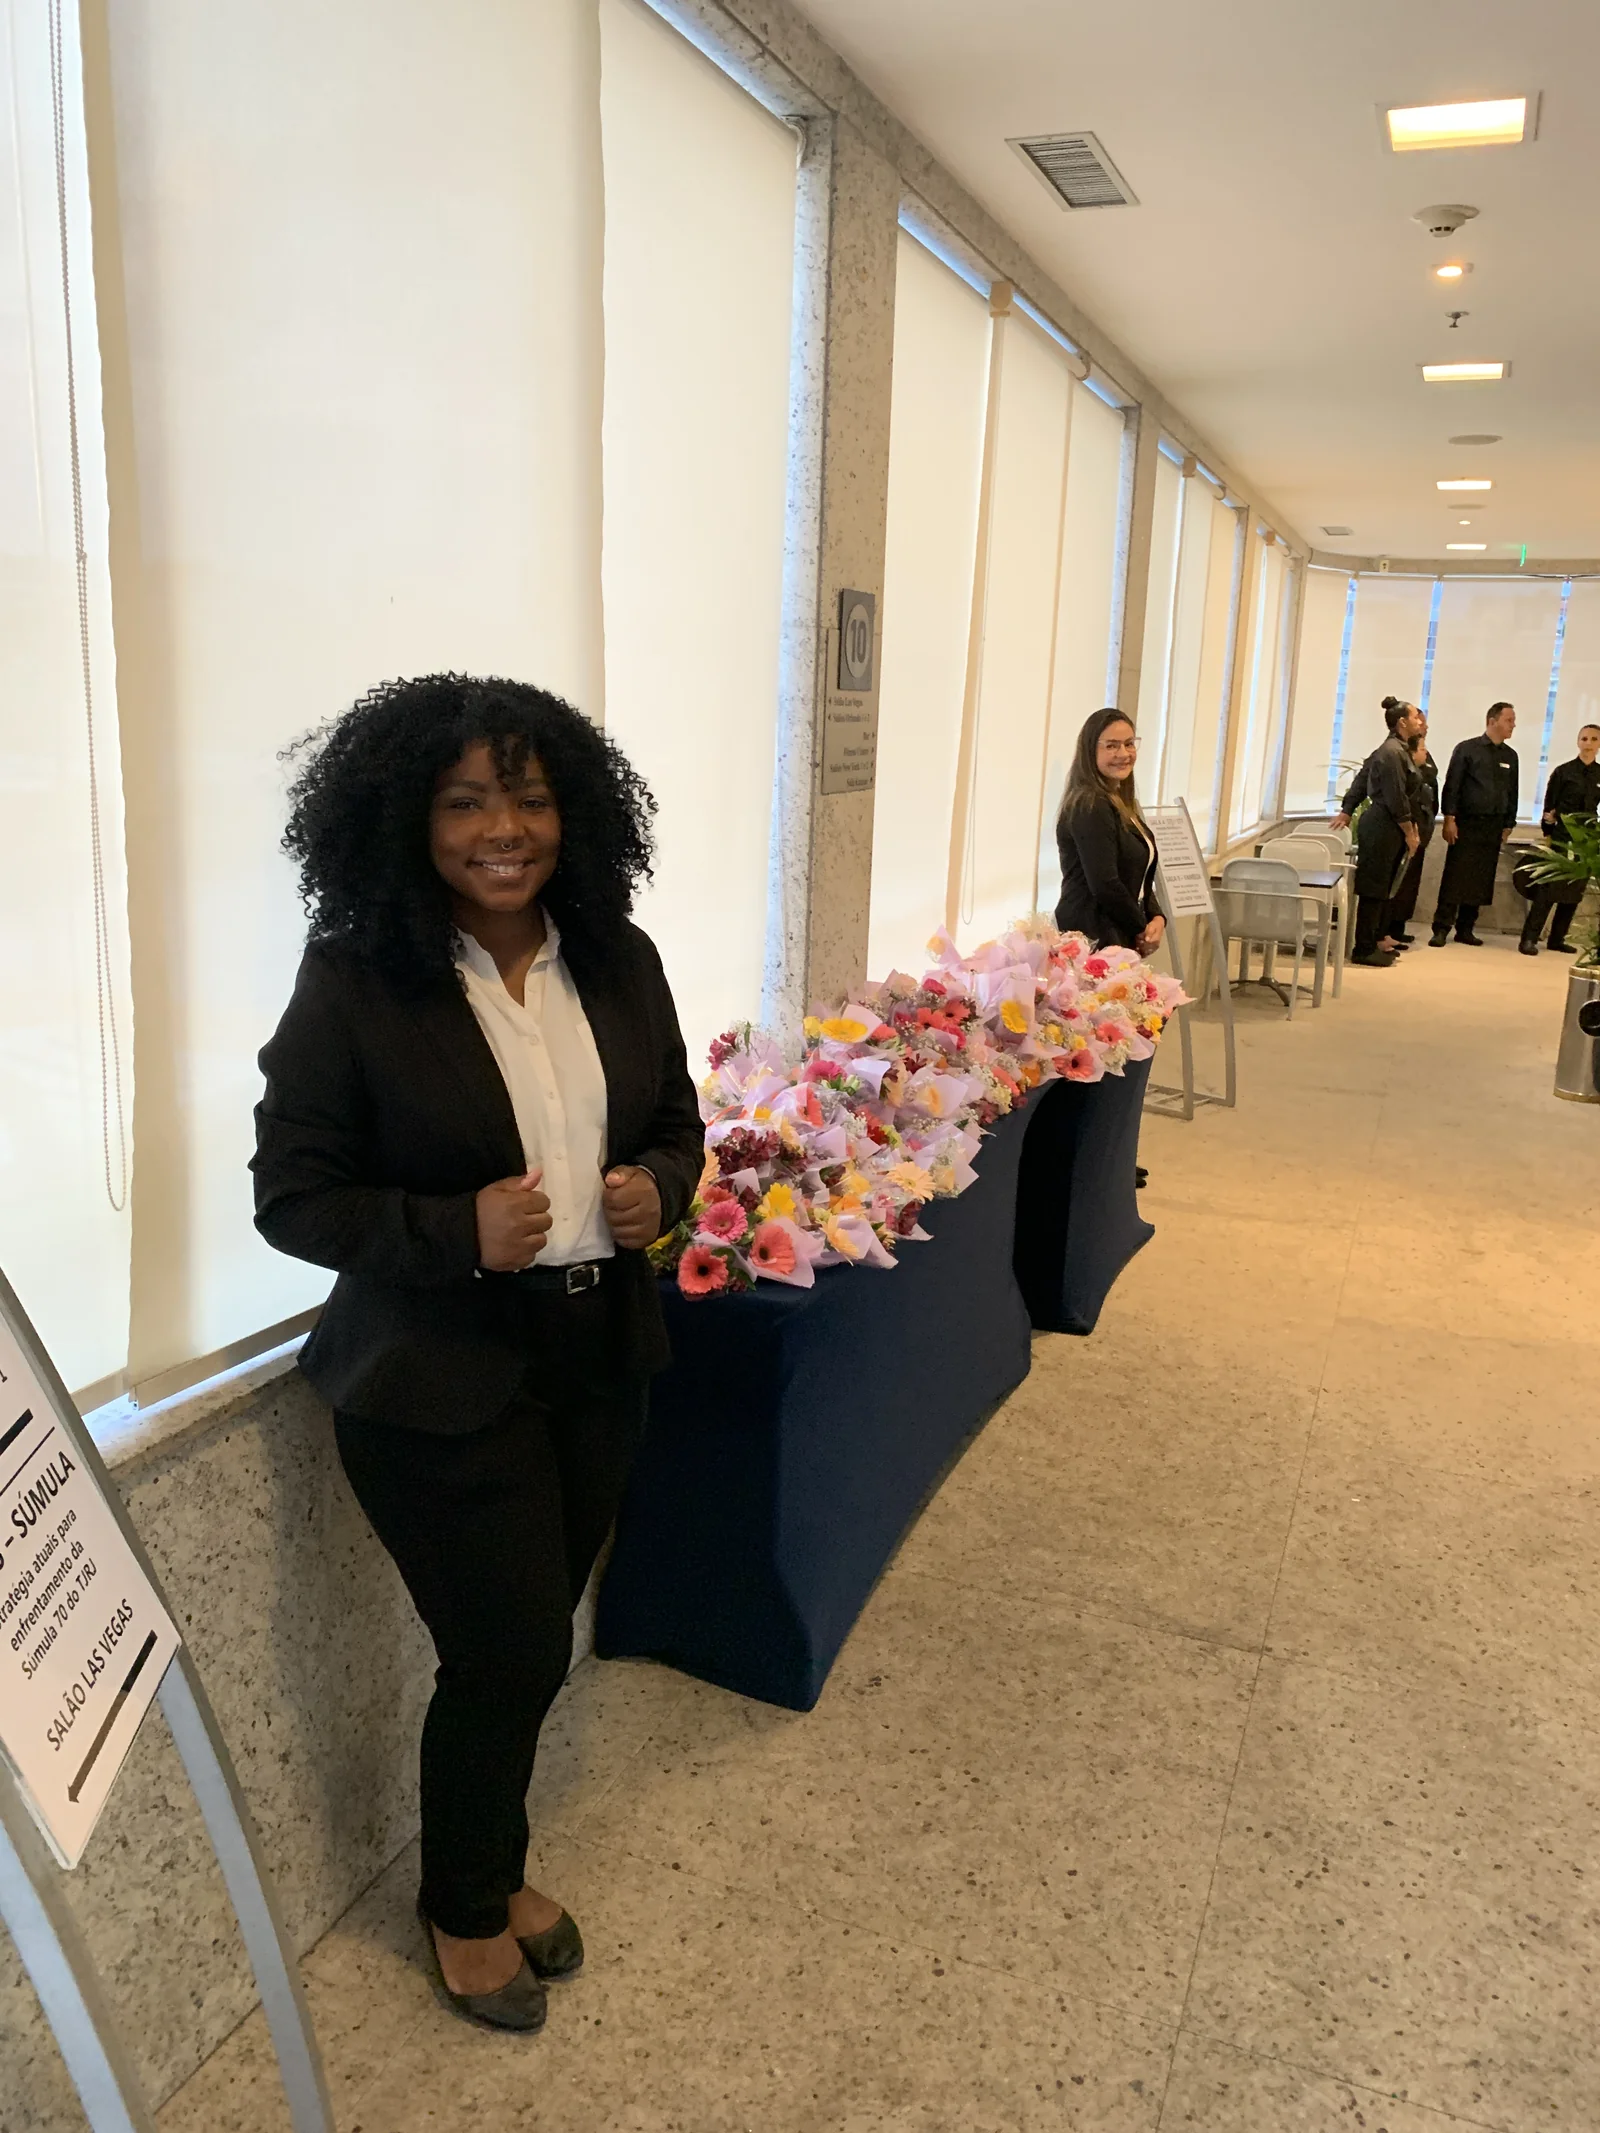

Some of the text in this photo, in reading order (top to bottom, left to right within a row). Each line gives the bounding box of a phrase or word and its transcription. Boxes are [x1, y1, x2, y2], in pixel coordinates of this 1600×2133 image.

[850, 618, 867, 664] 10
[11, 1451, 76, 1539] SÚMULA
[0, 1509, 77, 1630] tratégia atuais para
[10, 1540, 85, 1651] enfrentamento da
[21, 1558, 98, 1680] Súmula 70 do TJRJ
[47, 1598, 133, 1752] SALÃO LAS VEGAS
